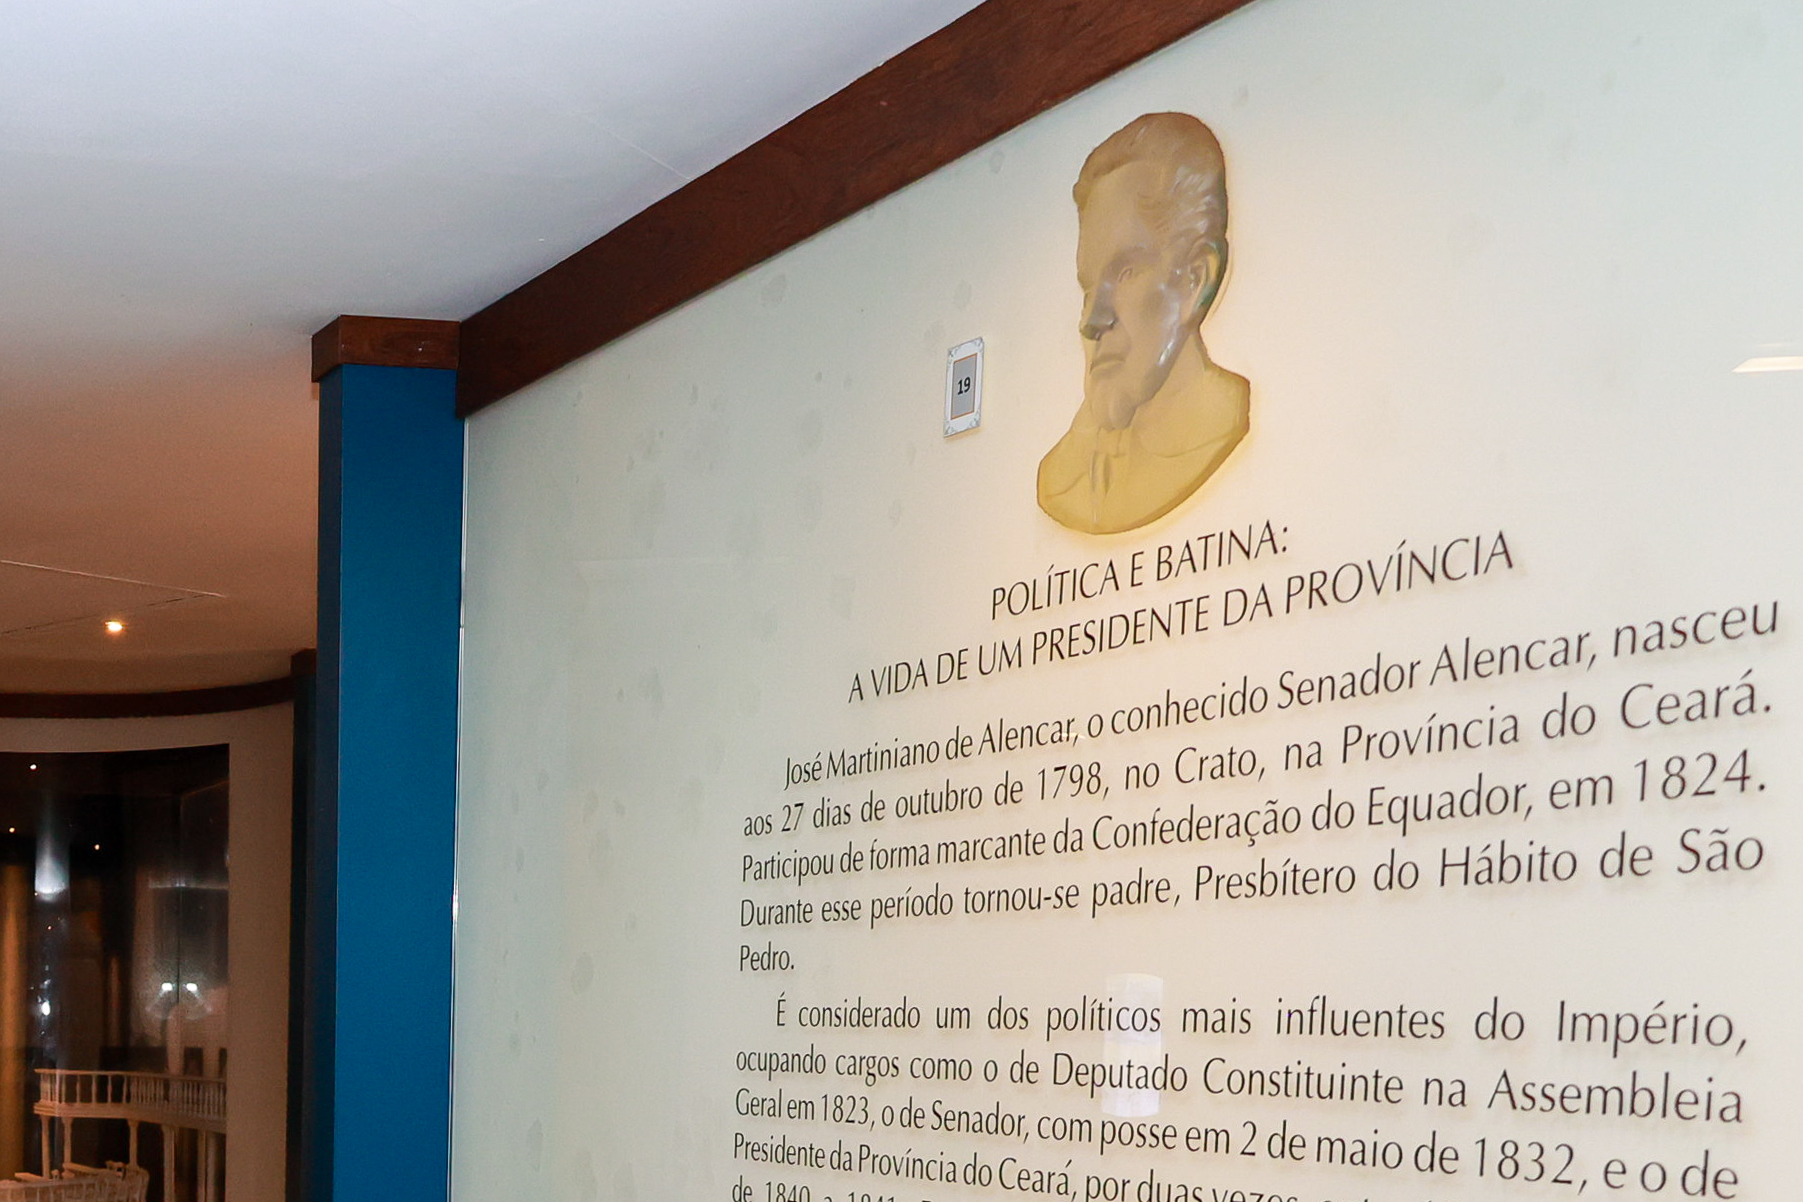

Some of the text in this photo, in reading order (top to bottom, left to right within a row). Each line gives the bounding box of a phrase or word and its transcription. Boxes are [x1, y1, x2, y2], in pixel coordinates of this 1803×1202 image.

[957, 376, 971, 396] 19
[848, 530, 1514, 704] A VIDA DE UM PRESIDENTE DA PROVÍNCIA
[992, 519, 1288, 621] POLÍTICA E BATINA:
[783, 600, 1778, 791] José Martiniano de Alencar, o conhecido Senador Alencar, nasceu
[777, 991, 1747, 1059] É considerado um dos políticos mais influentes do Império,
